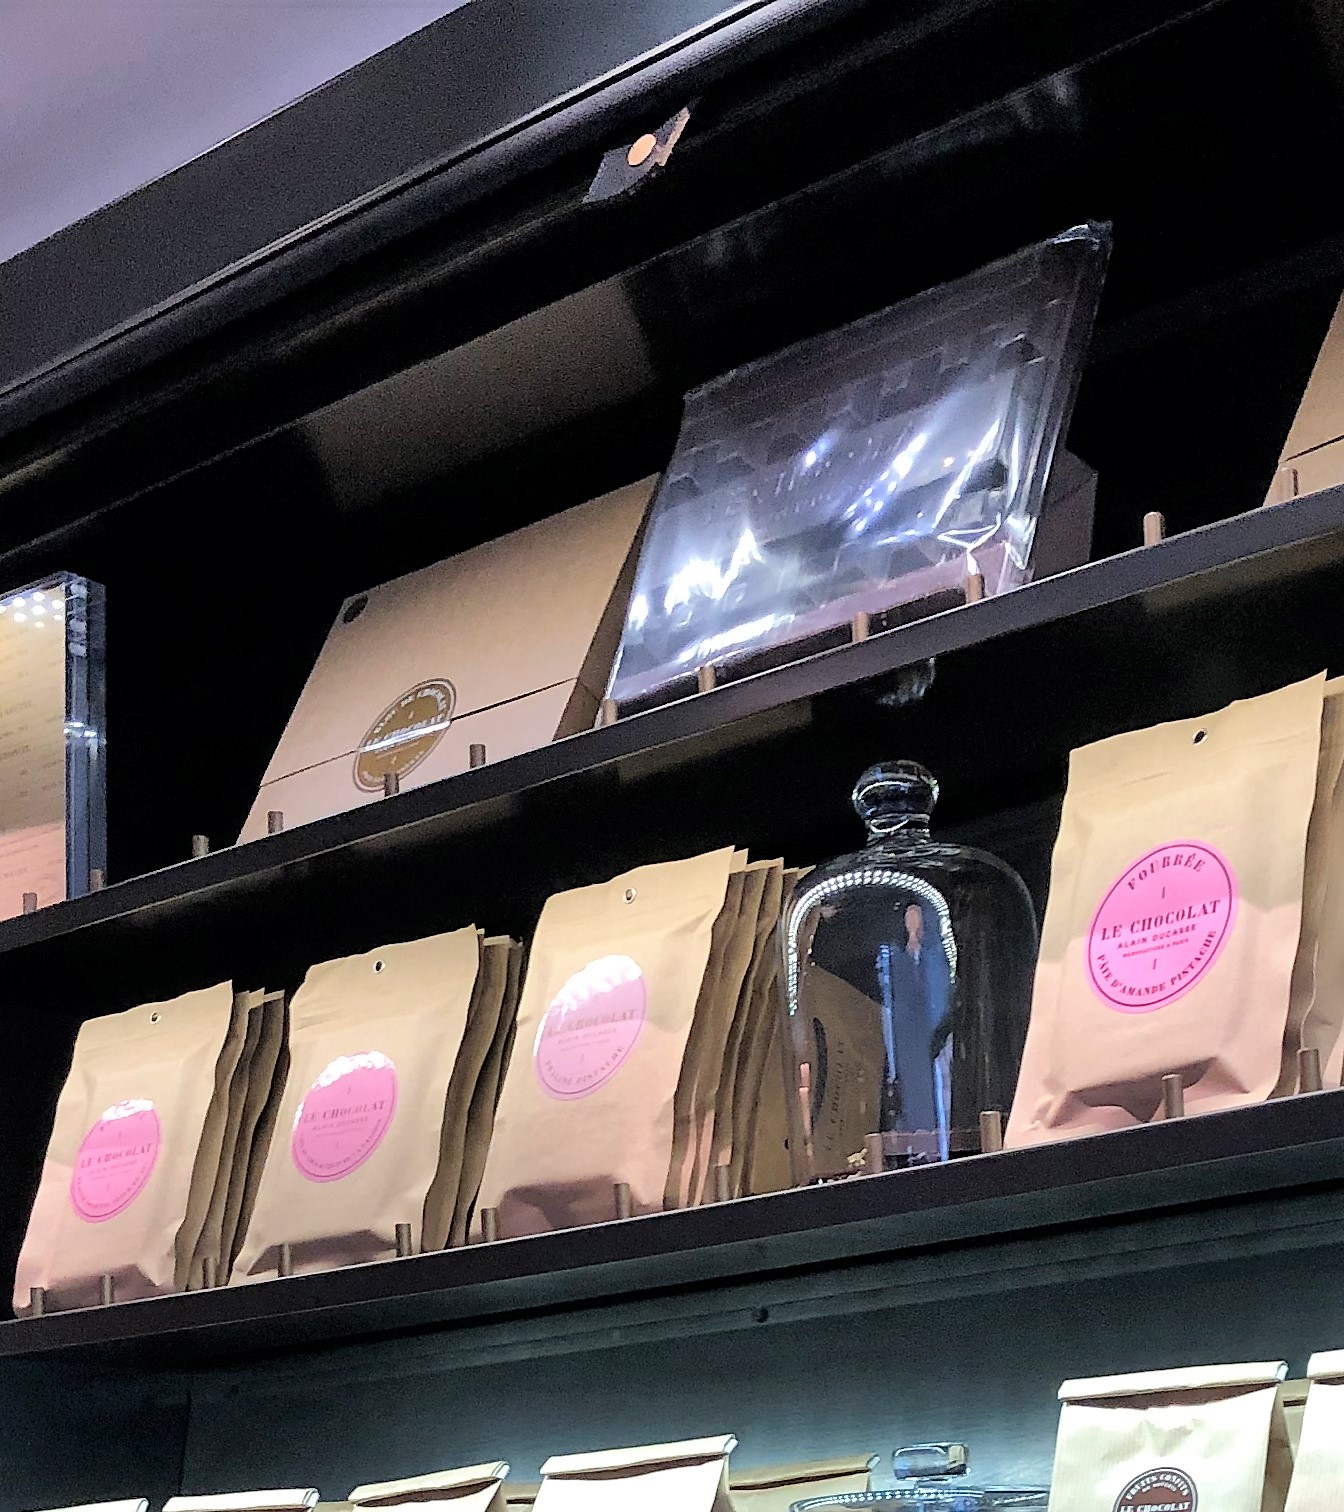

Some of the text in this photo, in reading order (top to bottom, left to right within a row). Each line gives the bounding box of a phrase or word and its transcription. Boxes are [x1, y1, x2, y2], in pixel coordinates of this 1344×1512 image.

[1126, 852, 1206, 891] FOURRÉE
[1100, 899, 1222, 942] LE CHOCOLAT
[1116, 923, 1198, 950] ALAIN DUCASSE
[566, 1008, 636, 1032] CHOCOLAT
[1136, 1501, 1191, 1512] CHOCOLAT
